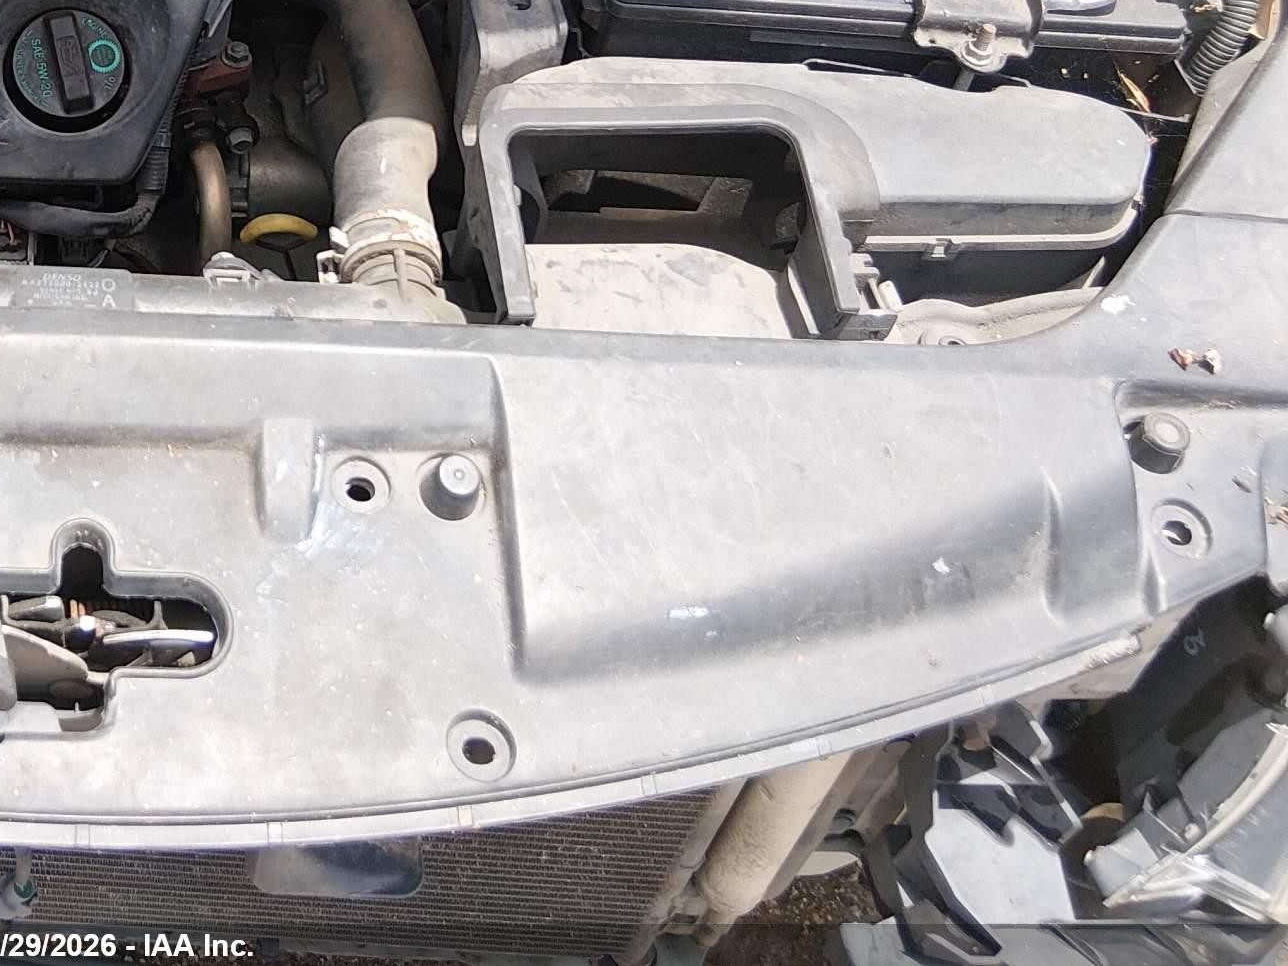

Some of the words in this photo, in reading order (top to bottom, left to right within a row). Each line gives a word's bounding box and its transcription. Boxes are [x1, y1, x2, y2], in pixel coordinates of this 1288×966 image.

[30, 38, 44, 60] SAE
[36, 61, 54, 99] 5W-20
[103, 76, 117, 91] OIL
[42, 272, 81, 281] DENSO
